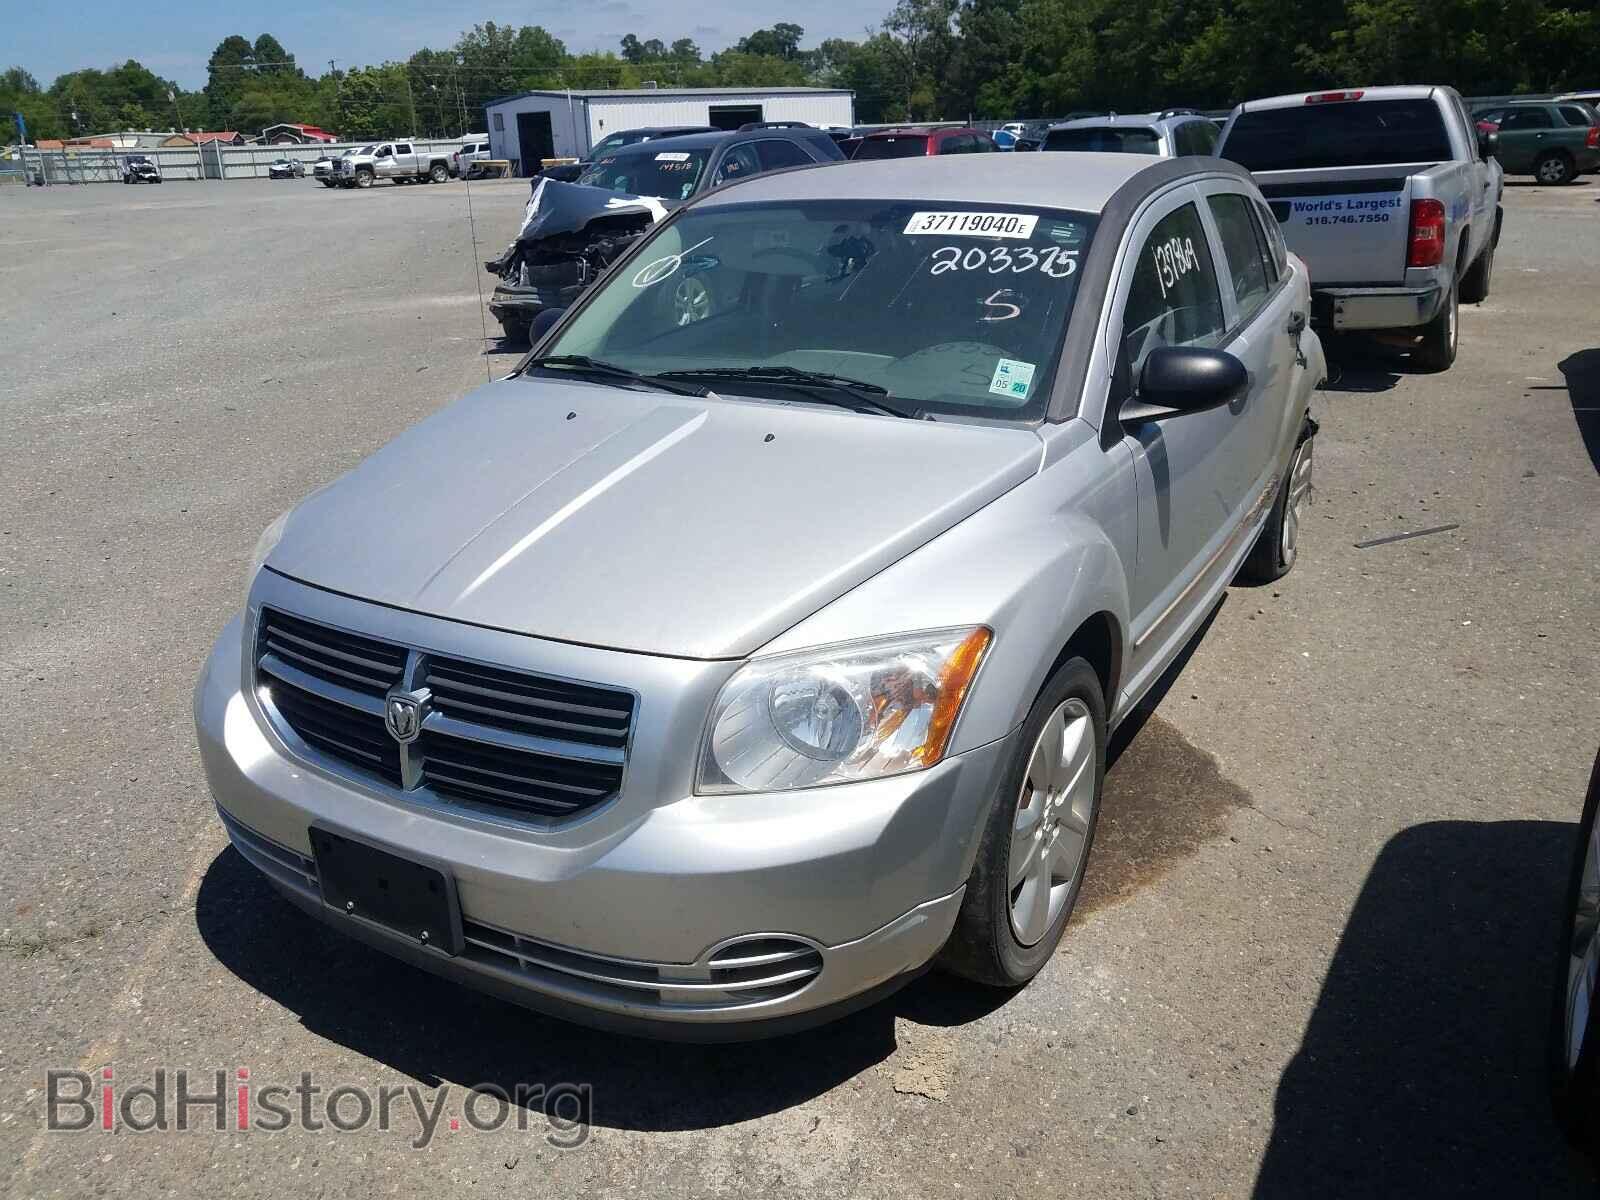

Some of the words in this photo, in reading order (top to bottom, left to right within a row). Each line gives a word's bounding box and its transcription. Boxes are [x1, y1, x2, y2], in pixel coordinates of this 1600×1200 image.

[1294, 201, 1343, 212] World's
[1347, 199, 1402, 211] Largest
[921, 215, 1018, 232] 37119040
[1012, 382, 1026, 393] 20
